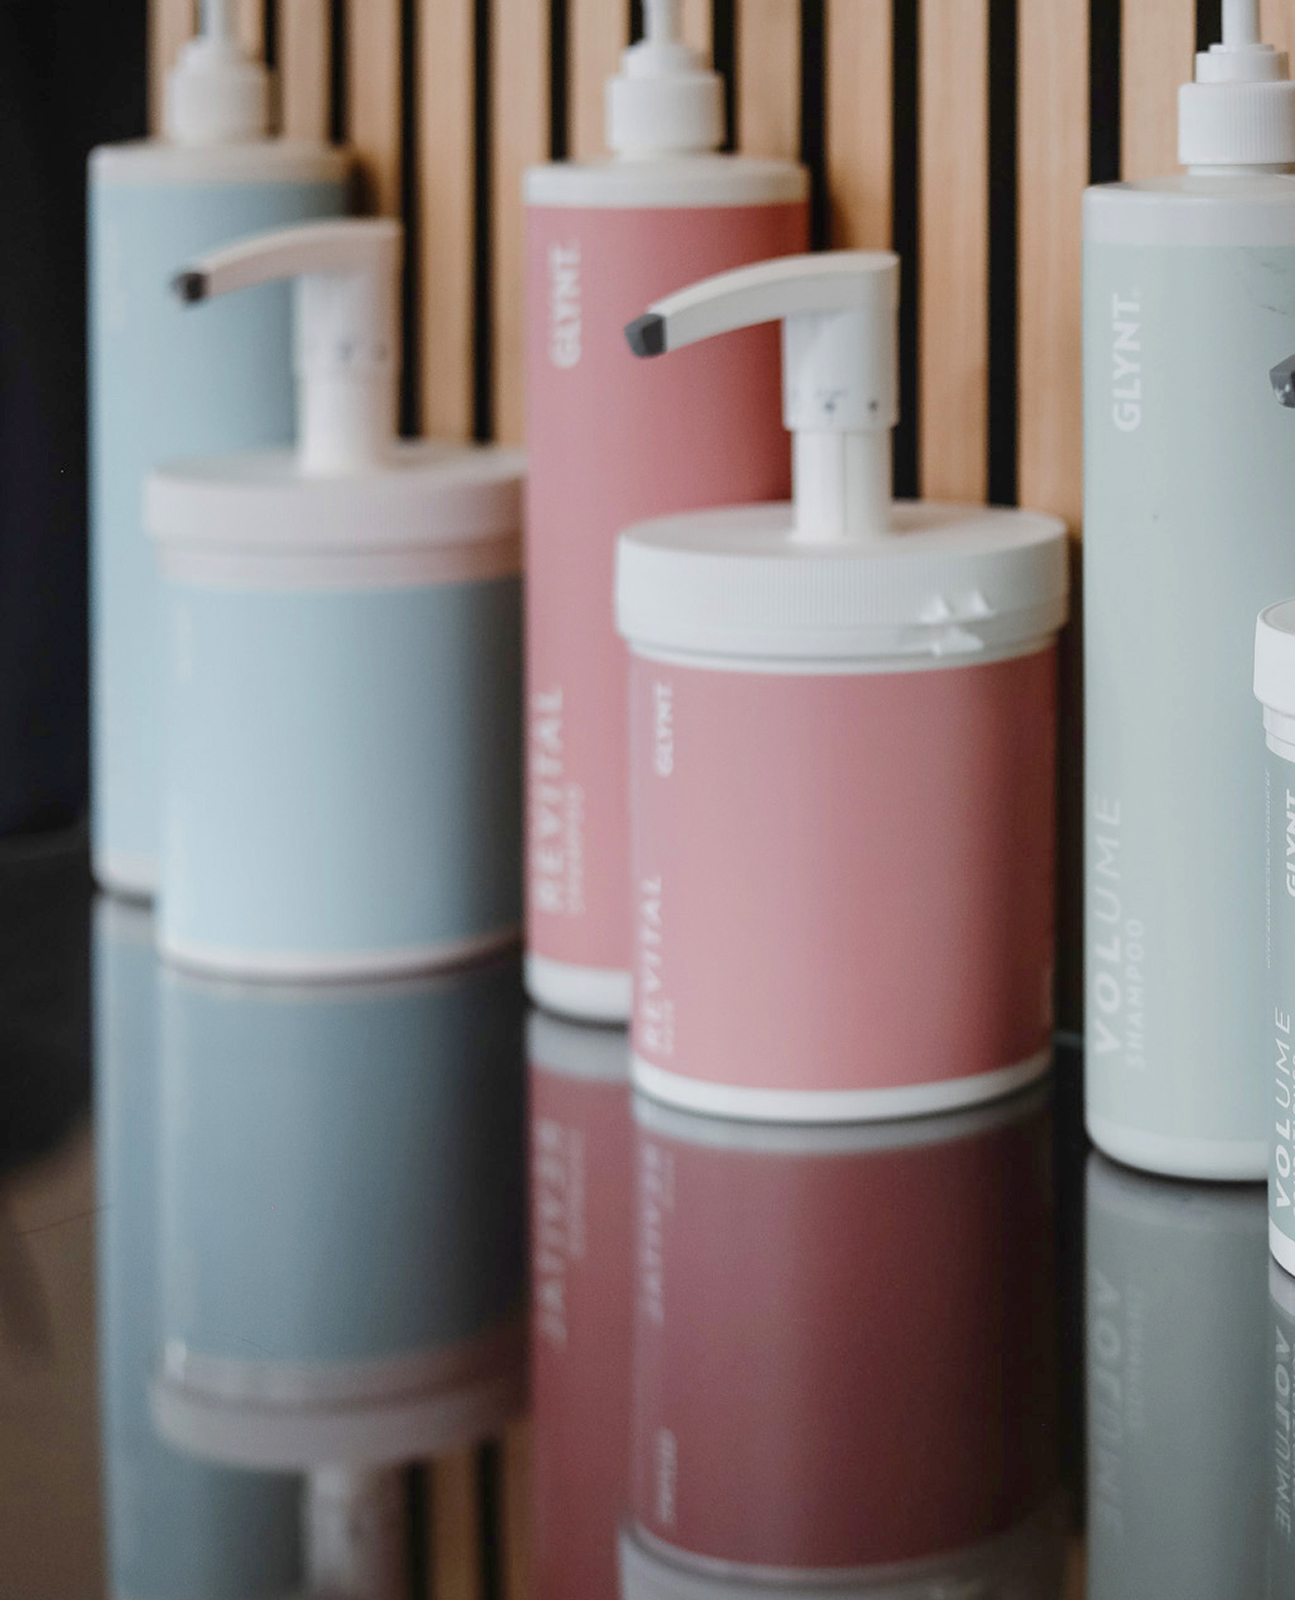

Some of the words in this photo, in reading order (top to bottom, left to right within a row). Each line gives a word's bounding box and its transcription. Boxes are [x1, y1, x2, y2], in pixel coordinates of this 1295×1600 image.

[533, 686, 563, 913] REVITAL
[641, 875, 662, 1056] REVITAL
[1094, 795, 1122, 1053] VOLUME
[1124, 918, 1145, 1070] SHAMPOO
[1275, 1006, 1291, 1208] VOLUME
